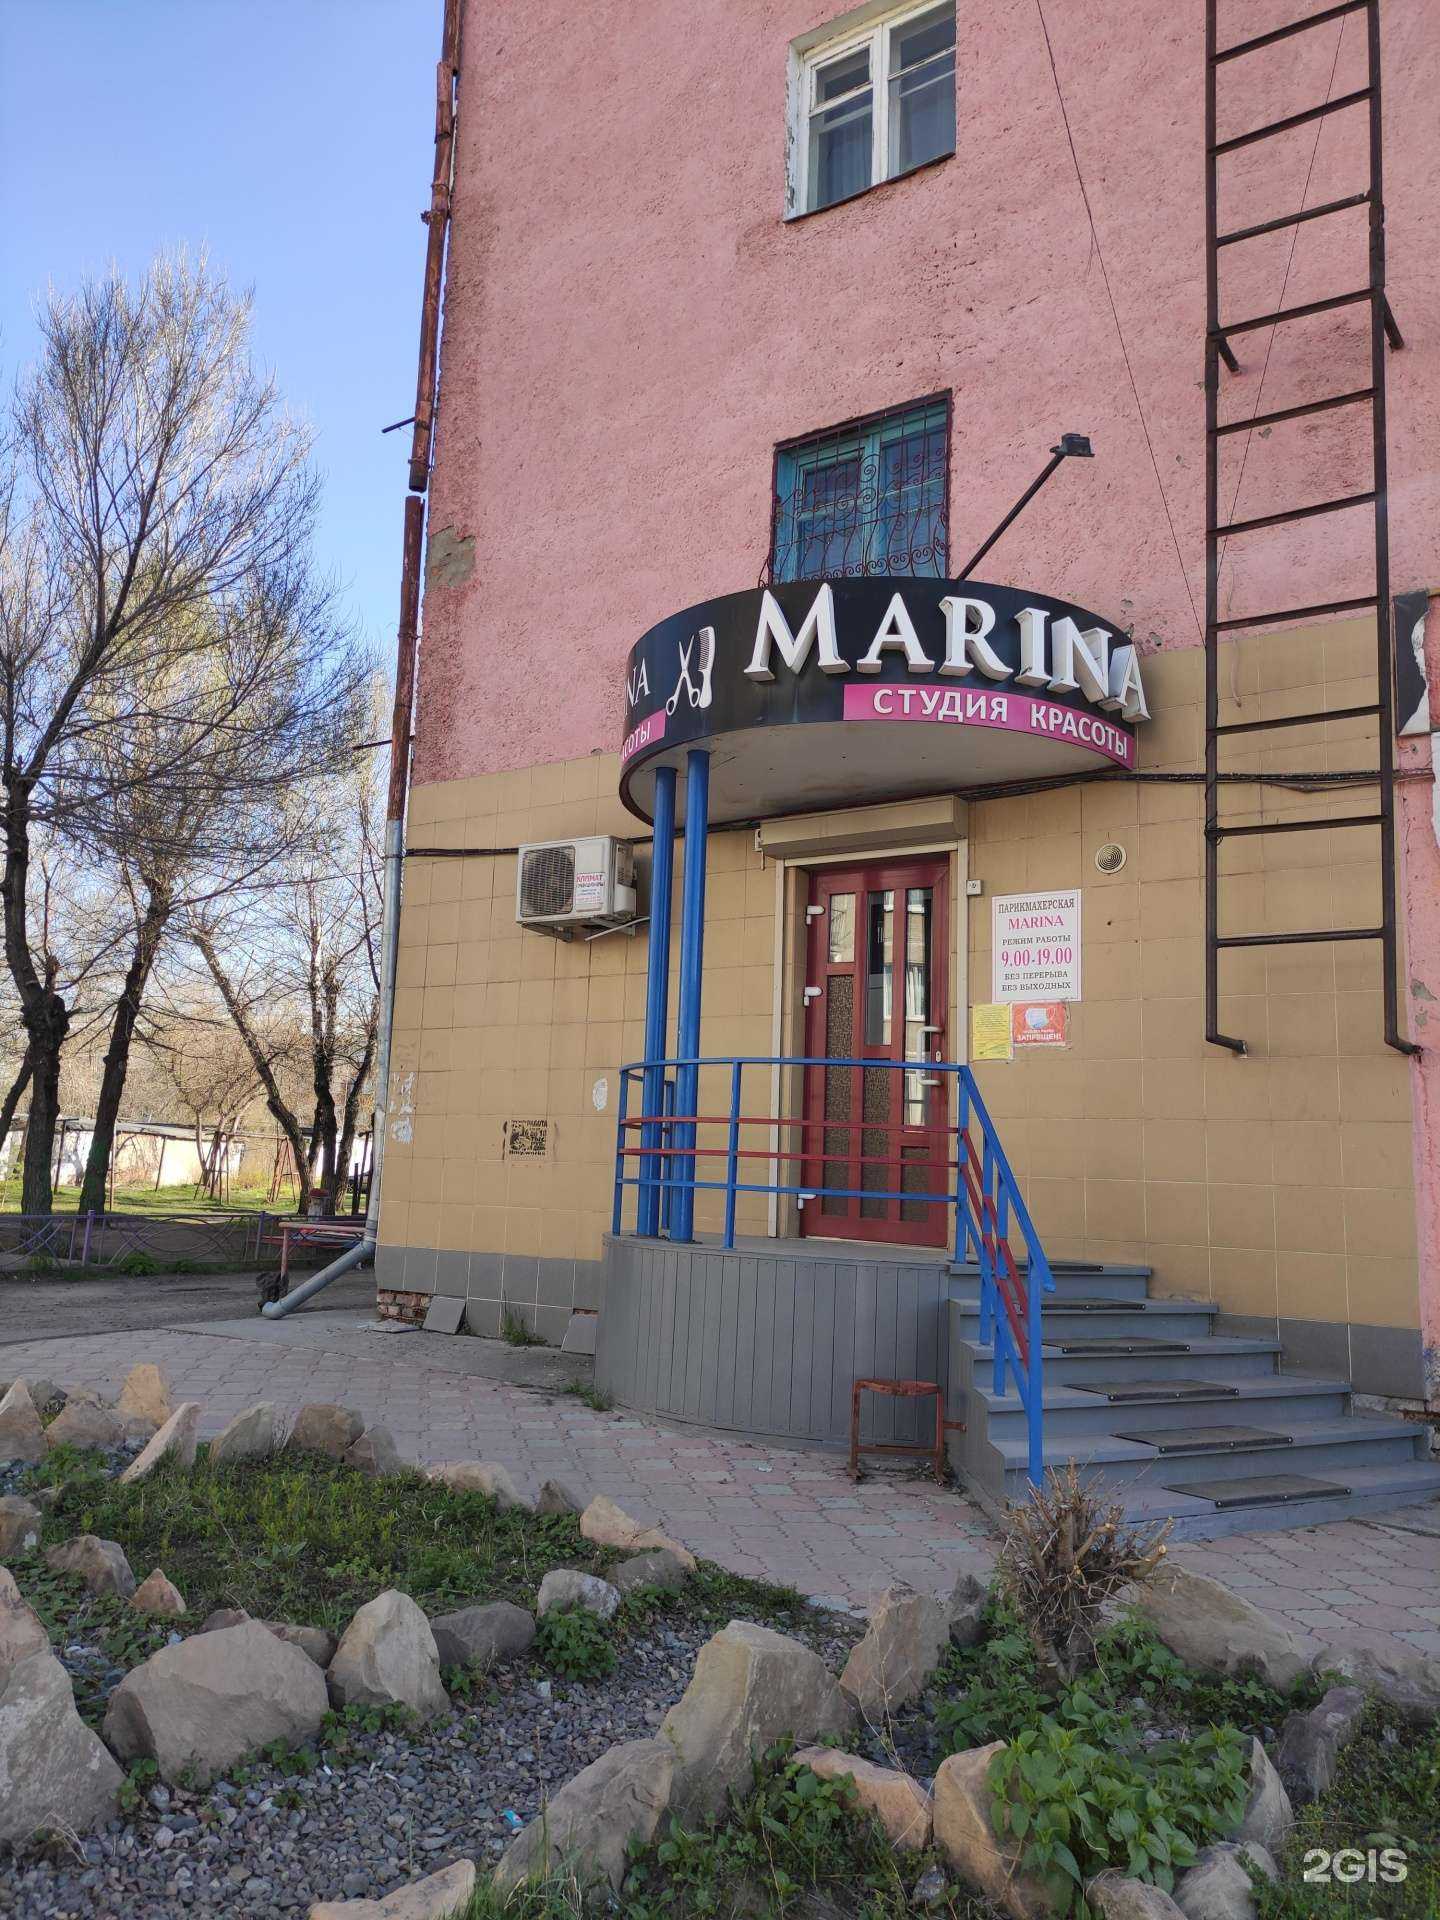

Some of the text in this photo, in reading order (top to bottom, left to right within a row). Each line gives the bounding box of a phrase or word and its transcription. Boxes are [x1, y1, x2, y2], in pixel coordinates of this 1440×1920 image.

[743, 583, 1151, 723] MARINA
[872, 688, 1129, 760] СТУДИЯ КРАСОТЫ
[623, 721, 651, 761] СОТЫ
[998, 898, 1075, 914] ПАРИКМАХЕРСКАЯ
[1008, 914, 1064, 931] MARINA
[1002, 935, 1071, 946] РЕЖИМ РАБОТЫ
[1004, 970, 1068, 981] БЕЗ ПЕРЕРЫВА
[1001, 982, 1072, 992] БЕЗ ВЫХОДНЫХ
